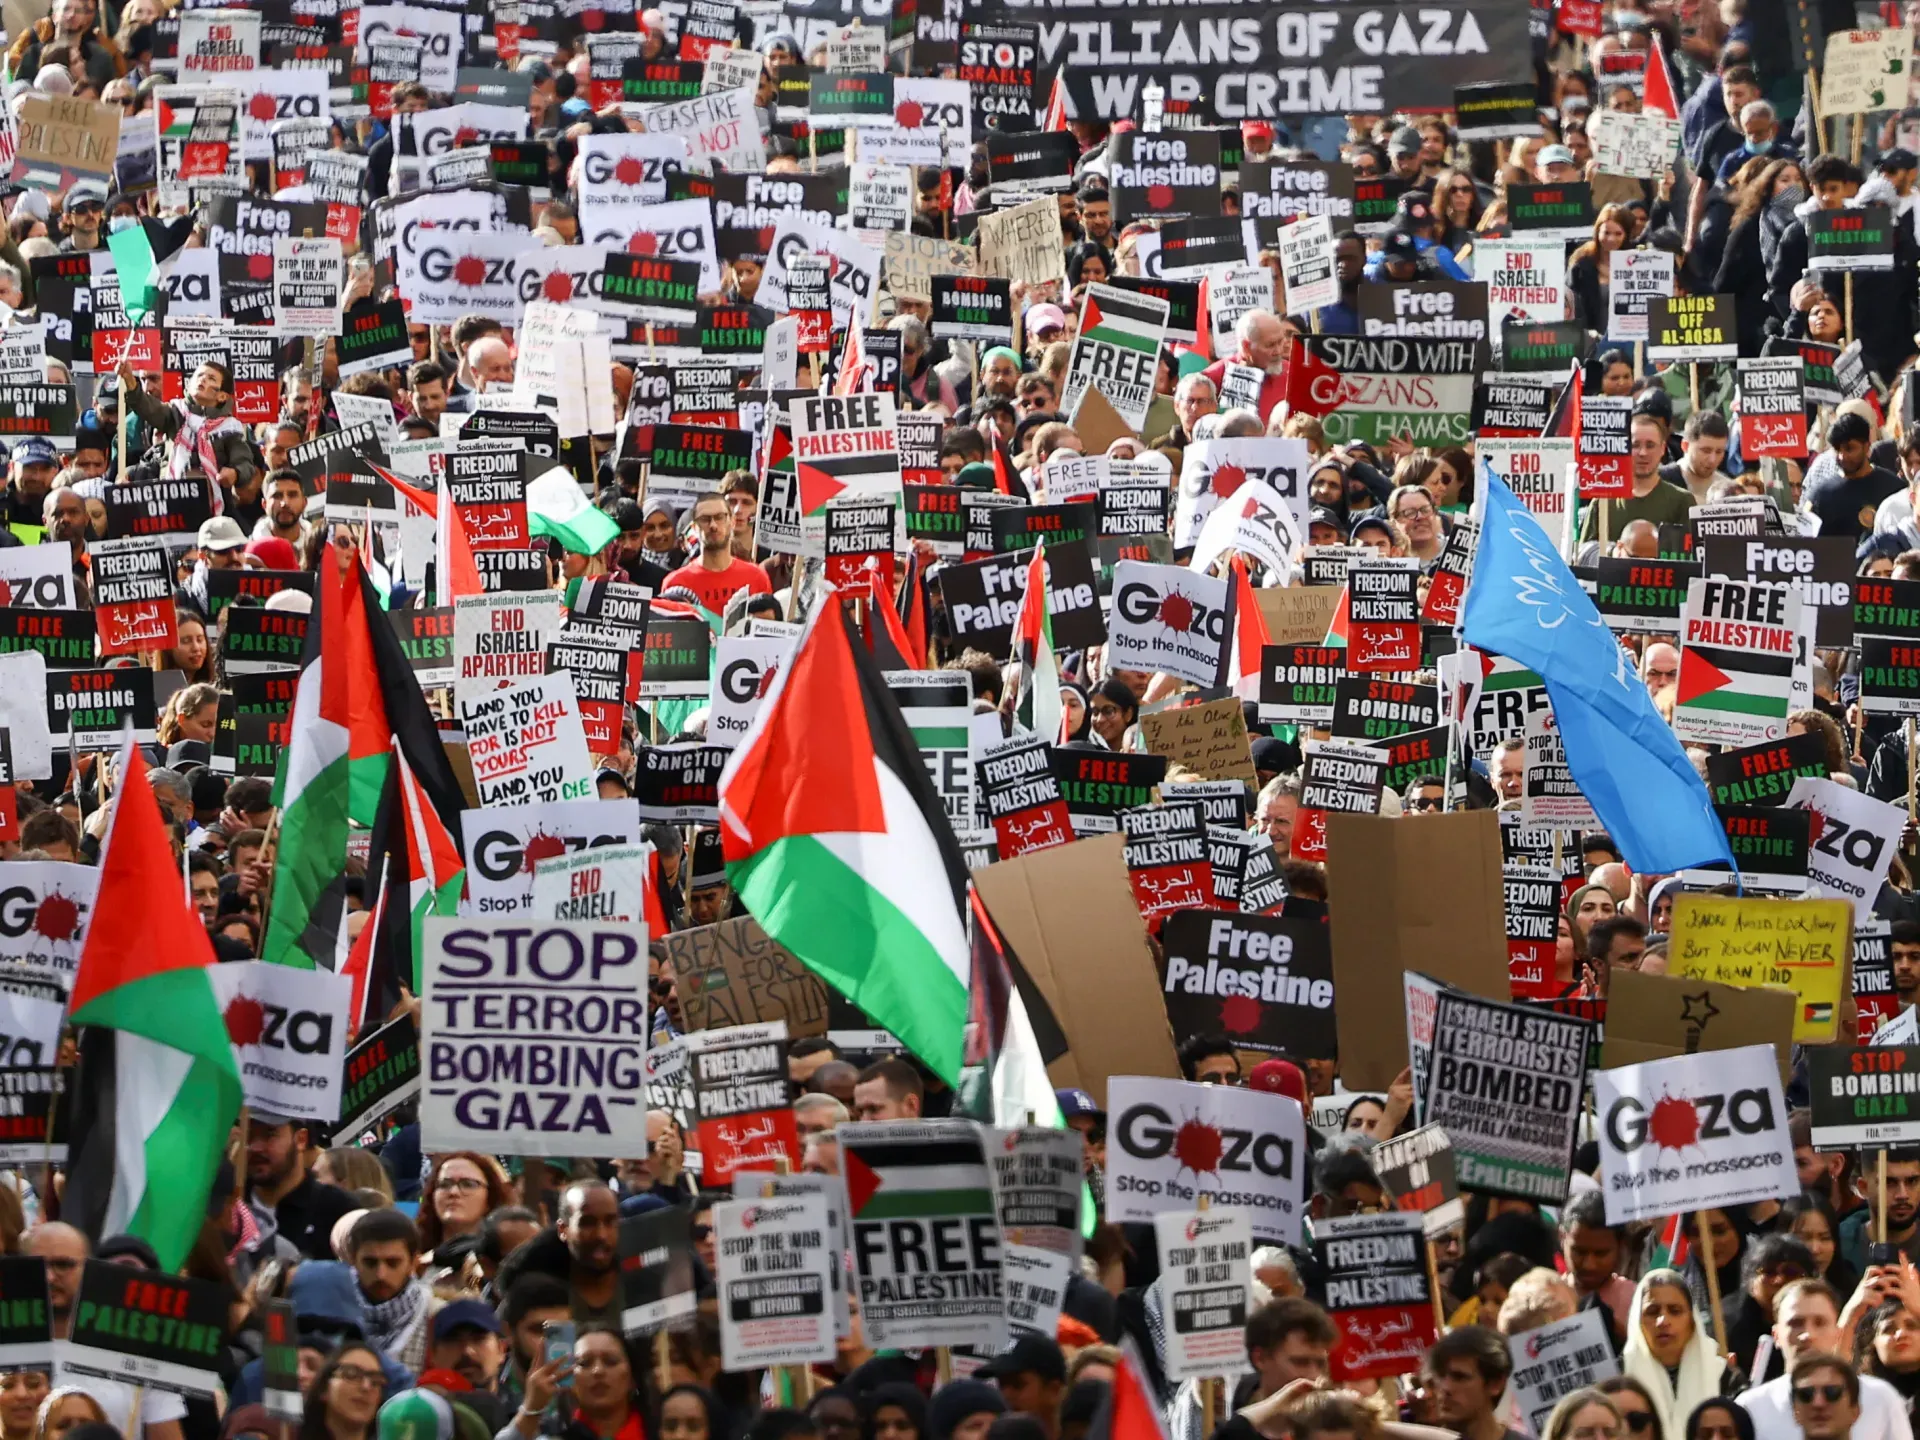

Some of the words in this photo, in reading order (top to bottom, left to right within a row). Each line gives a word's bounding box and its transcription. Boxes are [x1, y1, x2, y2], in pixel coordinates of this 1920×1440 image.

[208, 26, 233, 40] END
[1038, 19, 1263, 64] VILIANS
[1276, 12, 1339, 57] OF
[1353, 9, 1489, 56] GAZA
[961, 42, 1034, 68] STOP
[960, 65, 1032, 85] ISRAEL'S
[1214, 65, 1385, 118] CRIME
[1132, 136, 1187, 161] Free
[1111, 160, 1216, 188] Palestine
[1270, 167, 1329, 191] Free
[746, 177, 805, 202] Free
[1242, 188, 1350, 217] Palestine
[236, 204, 292, 231] Free
[277, 259, 301, 271] STOP
[302, 259, 319, 271] THE
[321, 259, 338, 270] WAR
[1506, 253, 1532, 269] END
[289, 271, 301, 282] ON
[604, 275, 695, 300] PALESTINE
[954, 278, 987, 292] STOP
[1494, 269, 1545, 286] ISRAELI
[1613, 269, 1633, 282] STOP
[1634, 270, 1649, 281] THE
[1650, 270, 1670, 282] WAR
[1624, 280, 1636, 291] ON
[1393, 288, 1455, 316] Free
[1667, 296, 1716, 314] HANDS
[1679, 313, 1704, 329] OFF
[342, 325, 398, 349] PALESTINE
[1661, 326, 1723, 345] AL-AQSA
[1071, 341, 1156, 386] FREE
[1320, 336, 1409, 373] STAND
[1417, 338, 1475, 372] WITH
[674, 369, 732, 387] FREEDOM
[1743, 371, 1797, 390] FREEDOM
[673, 391, 736, 411] PALESTINE
[1488, 387, 1545, 407] FREEDOM
[1742, 393, 1801, 414] PALESTINE
[805, 397, 883, 434] FREE
[1375, 413, 1470, 442] HAMAS
[1484, 408, 1546, 429] PALESTINE
[287, 423, 374, 467] SANCTIONS
[682, 432, 724, 451] FREE
[798, 429, 894, 456] PALESTINE
[453, 453, 518, 475] FREEDOM
[653, 452, 749, 472] PALESTINE
[1047, 461, 1097, 480] FREE
[1509, 453, 1541, 473] END
[111, 481, 199, 501] SANCTIONS
[451, 479, 522, 502] PALESTINE
[1104, 488, 1161, 509] FREEDOM
[147, 501, 168, 516] ON
[464, 507, 512, 524] الحرية
[832, 507, 888, 527] FREEDOM
[1101, 515, 1164, 534] PALESTINE
[1697, 518, 1758, 537] FREEDOM
[828, 534, 891, 552] PALESTINE
[100, 552, 162, 575] FREEDOM
[1746, 543, 1815, 573] Free
[100, 575, 169, 602] PALESTINE
[1354, 572, 1410, 593] FREEDOM
[1629, 567, 1673, 587] FREE
[112, 604, 160, 624] الحرية
[1352, 599, 1415, 621] PALESTINE
[1702, 583, 1786, 625] FREE
[17, 615, 63, 636] FREE
[491, 609, 525, 632] END
[475, 629, 542, 654] ISRAELI
[559, 634, 587, 645] Socialist
[588, 638, 618, 649] Worker
[1152, 636, 1175, 651] the
[1362, 628, 1404, 643] الحرية
[1687, 620, 1793, 653] PALESTINE
[552, 649, 620, 673] FREEDOM
[1293, 649, 1340, 666] STOP
[70, 674, 115, 692] STOP
[887, 675, 925, 686] Solidarity
[927, 673, 967, 686] Campaign
[1368, 682, 1416, 700] STOP
[53, 690, 135, 710] BOMBING
[507, 686, 544, 706] YOU
[72, 709, 117, 727] GAZA
[465, 718, 507, 740] HAVE
[509, 710, 530, 727] TO
[533, 701, 569, 724] KILL
[1347, 700, 1433, 725] BOMBING
[1364, 719, 1410, 738] GAZA
[1706, 718, 1730, 729] Forum
[1741, 722, 1764, 732] Britain
[469, 736, 500, 757] FOR
[504, 732, 519, 747] IS
[520, 720, 557, 743] NOT
[984, 749, 1049, 783] FREEDOM
[1079, 759, 1129, 783] FREE
[1310, 757, 1379, 784] FREEDOM
[1741, 747, 1791, 778] FREE
[480, 781, 527, 804] LAND
[528, 765, 564, 790] YOU
[562, 777, 592, 798] DIE
[1716, 763, 1827, 804] PALESTINE
[988, 777, 1059, 816] PALESTINE
[1304, 790, 1377, 814] PALESTINE
[1124, 803, 1196, 834] FREEDOM
[1725, 817, 1768, 836] FREE
[570, 867, 599, 897] END
[1209, 919, 1293, 964] Free
[1774, 938, 1835, 962] NEVER
[438, 928, 638, 981] STOP
[1164, 957, 1334, 1010] Palestine
[432, 995, 643, 1035] TERROR
[1446, 1001, 1520, 1040] ISRAELI
[1523, 1017, 1582, 1050] STATE
[699, 1048, 780, 1078] FREEDOM
[1441, 1026, 1580, 1078] TERRORISTS
[1851, 1049, 1906, 1073] STOP
[242, 1061, 329, 1090] massacre
[430, 1042, 642, 1090] BOMBING
[1438, 1055, 1574, 1114] BOMBED
[454, 1088, 612, 1135] GAZA
[1649, 1167, 1680, 1184] the
[1685, 1150, 1783, 1180] massacre
[1117, 1173, 1161, 1197] Stop
[1165, 1180, 1195, 1199] the
[1199, 1187, 1294, 1215] massacre
[855, 1216, 998, 1276] FREE
[1325, 1234, 1416, 1268] FREEDOM
[860, 1270, 1002, 1303] PALESTINE
[1325, 1273, 1428, 1307] PALESTINE
[124, 1279, 190, 1319] FREE
[77, 1300, 222, 1357] PALESTINE
